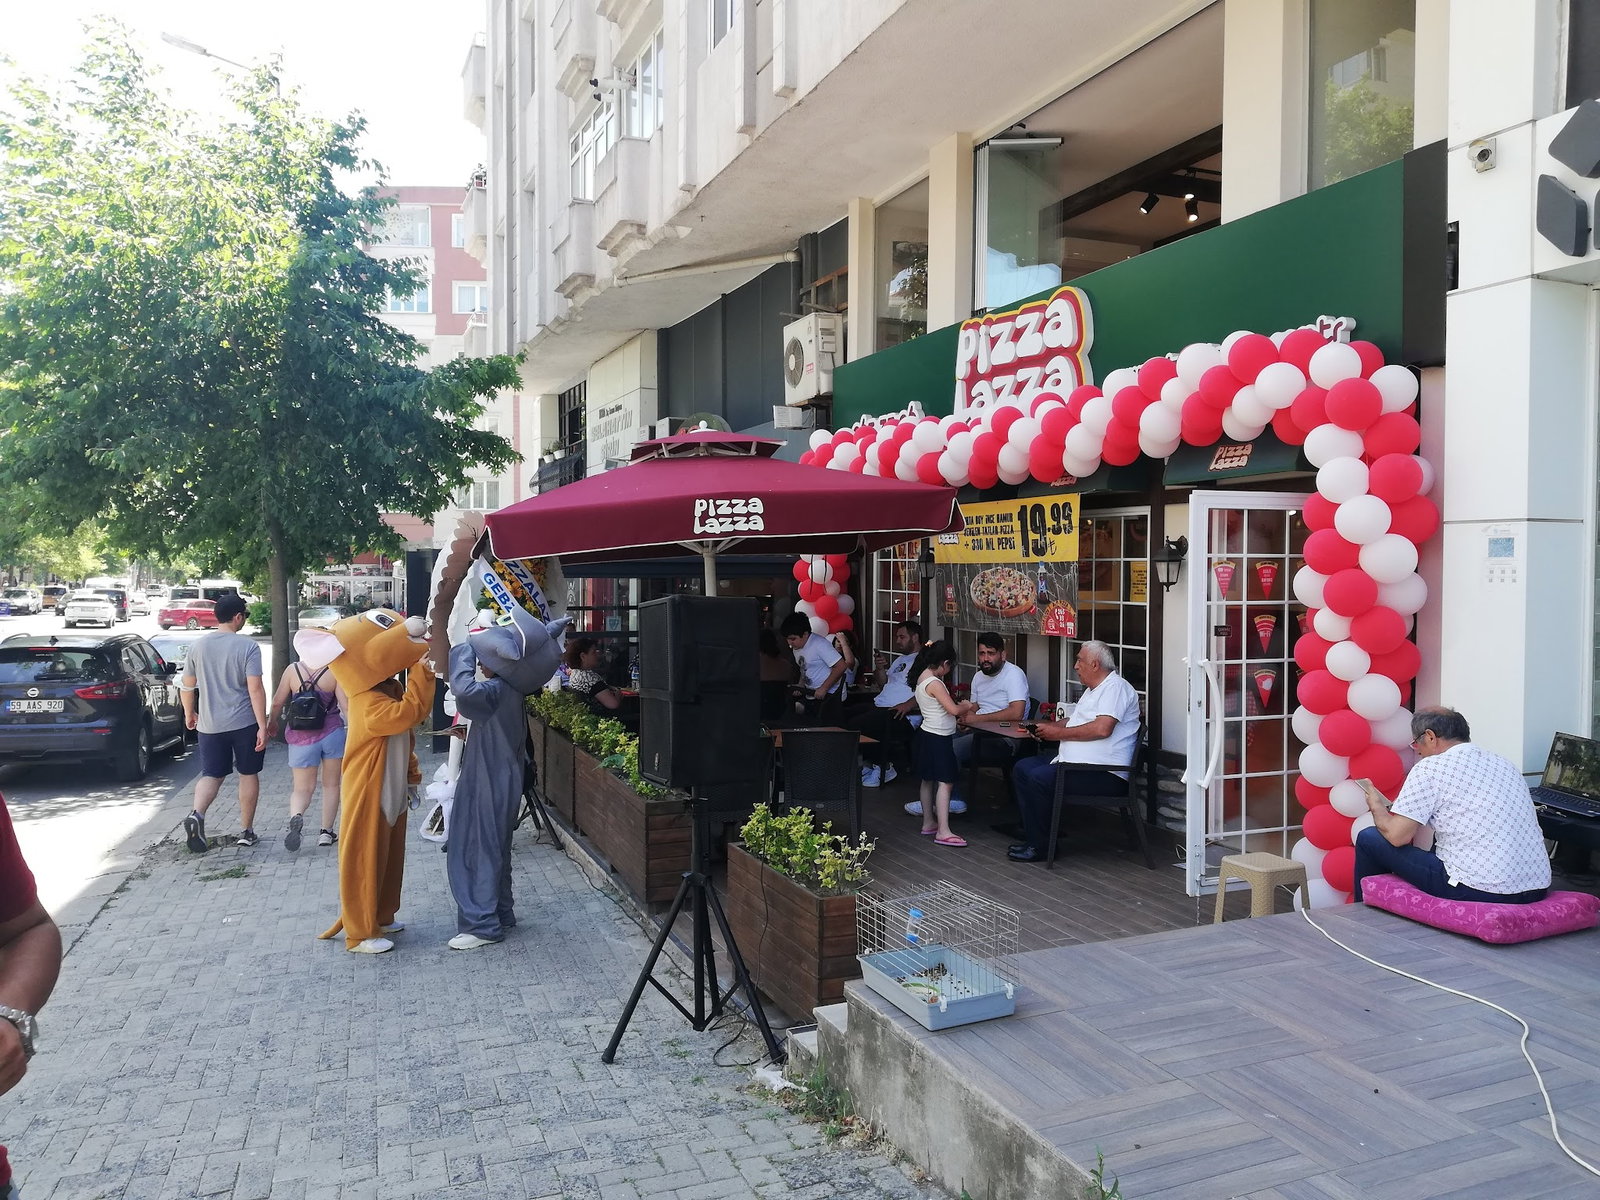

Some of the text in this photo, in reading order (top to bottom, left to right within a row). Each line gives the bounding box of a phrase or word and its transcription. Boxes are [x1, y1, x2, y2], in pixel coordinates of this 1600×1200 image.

[971, 538, 983, 551] 330
[11, 700, 63, 710] 59 AAS 920
